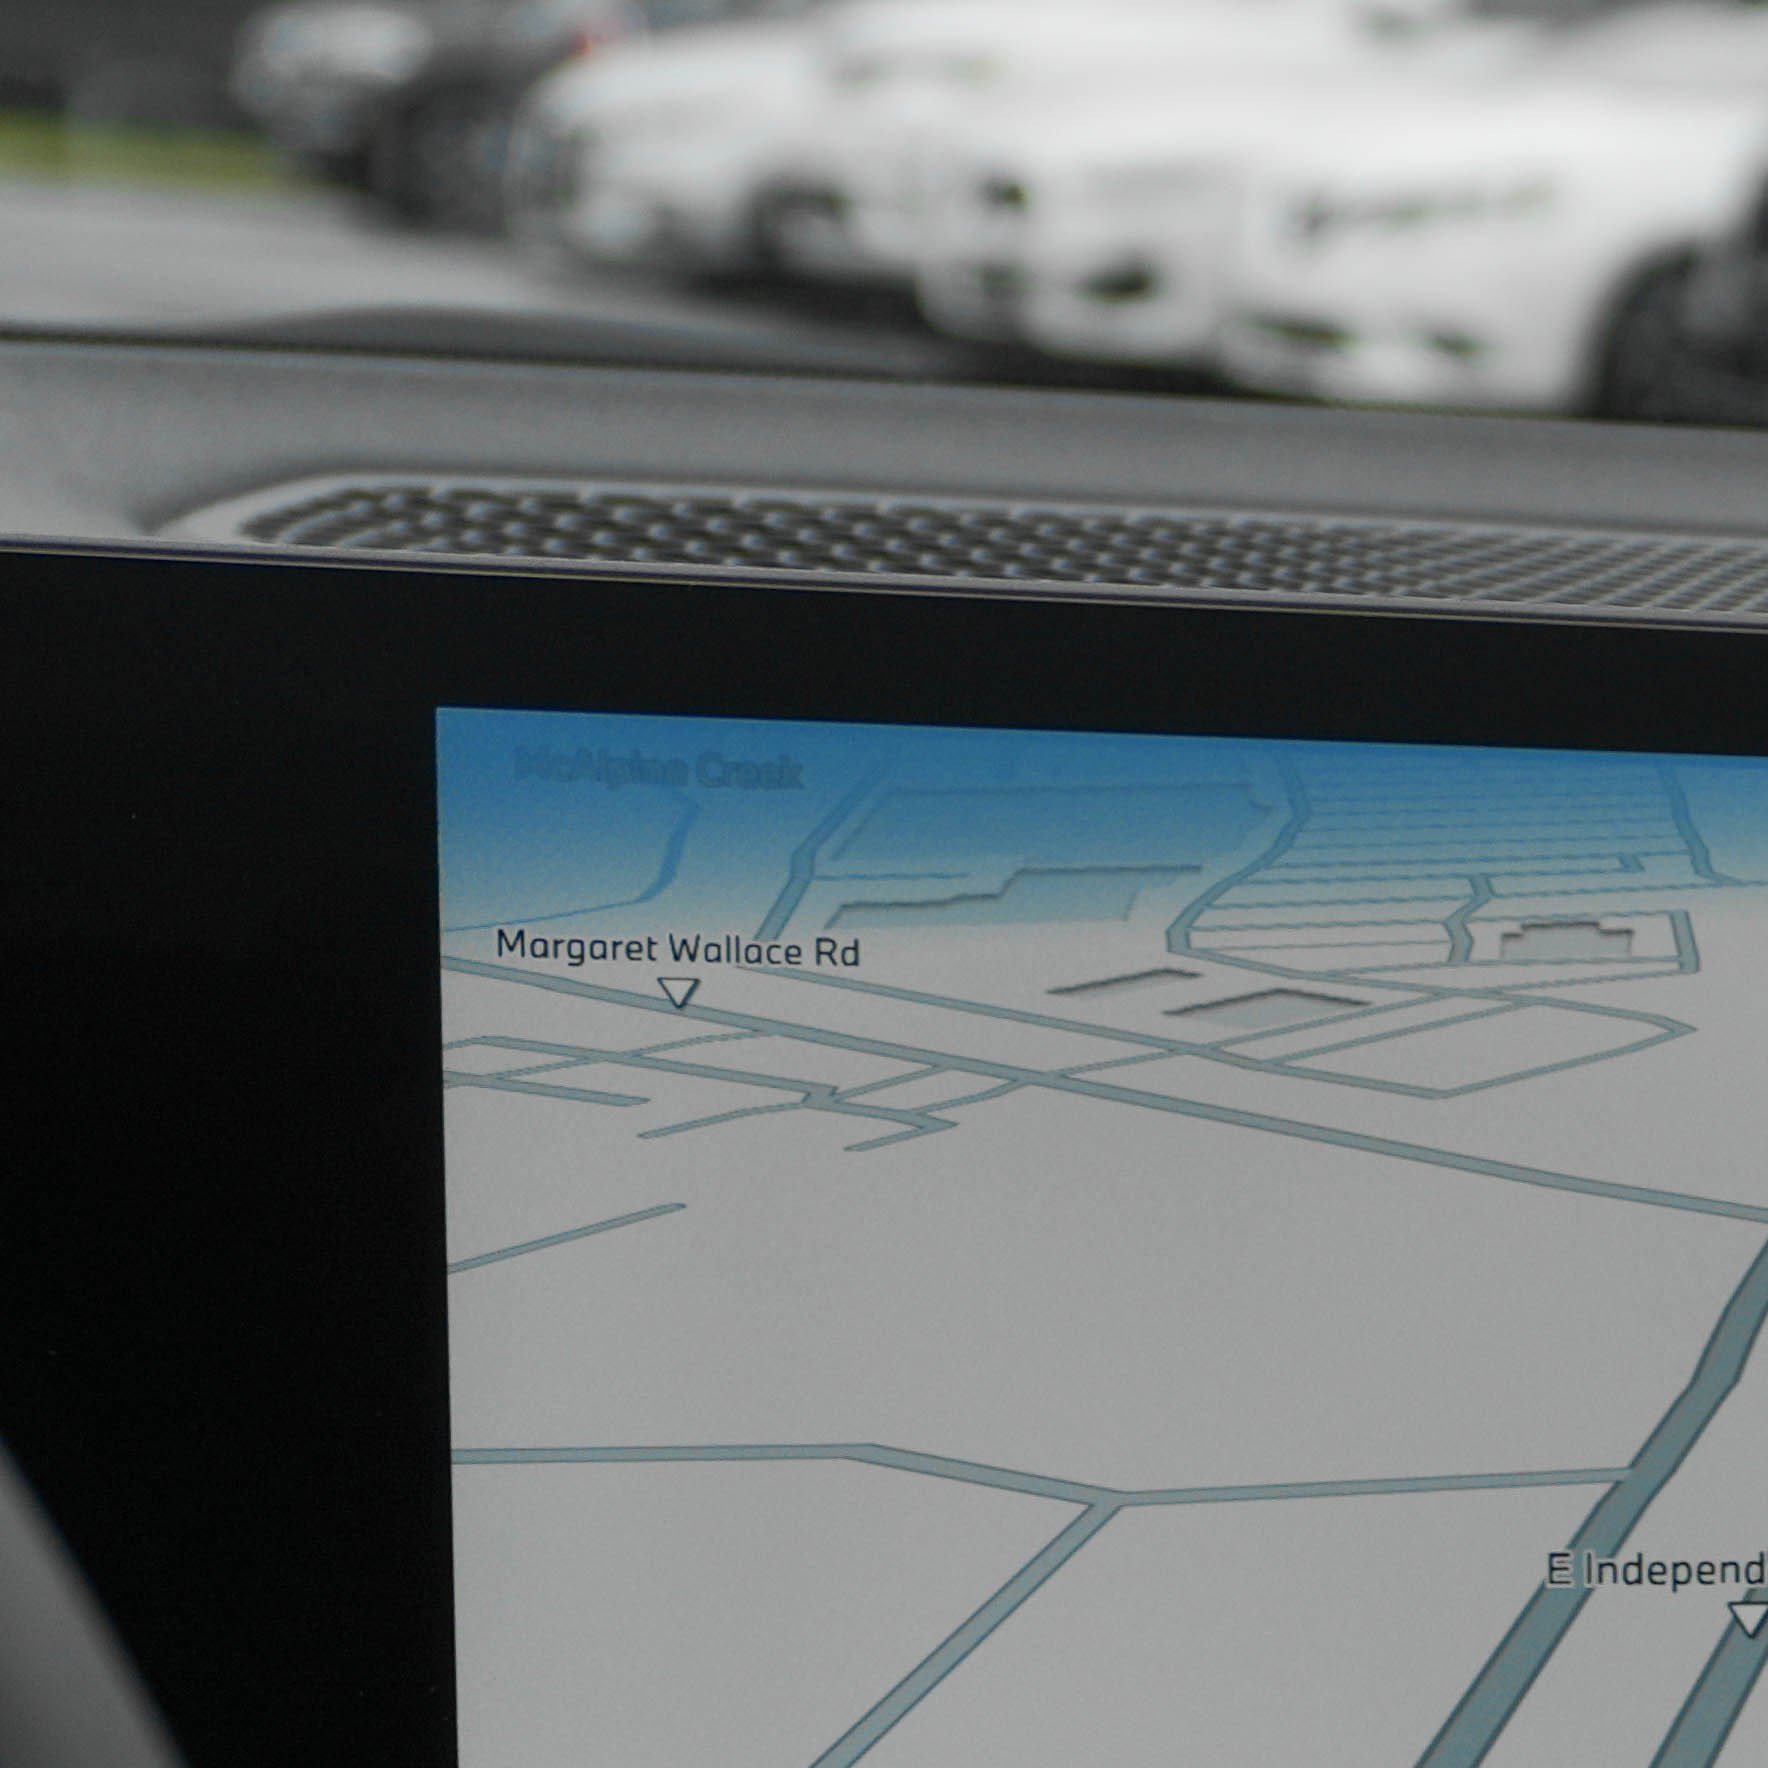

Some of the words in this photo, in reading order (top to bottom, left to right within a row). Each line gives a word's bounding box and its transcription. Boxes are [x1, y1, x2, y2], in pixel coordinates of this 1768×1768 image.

[497, 928, 658, 967] Margaret
[669, 933, 802, 965] Wallace
[815, 937, 861, 967] Rd
[1547, 1551, 1573, 1586] E
